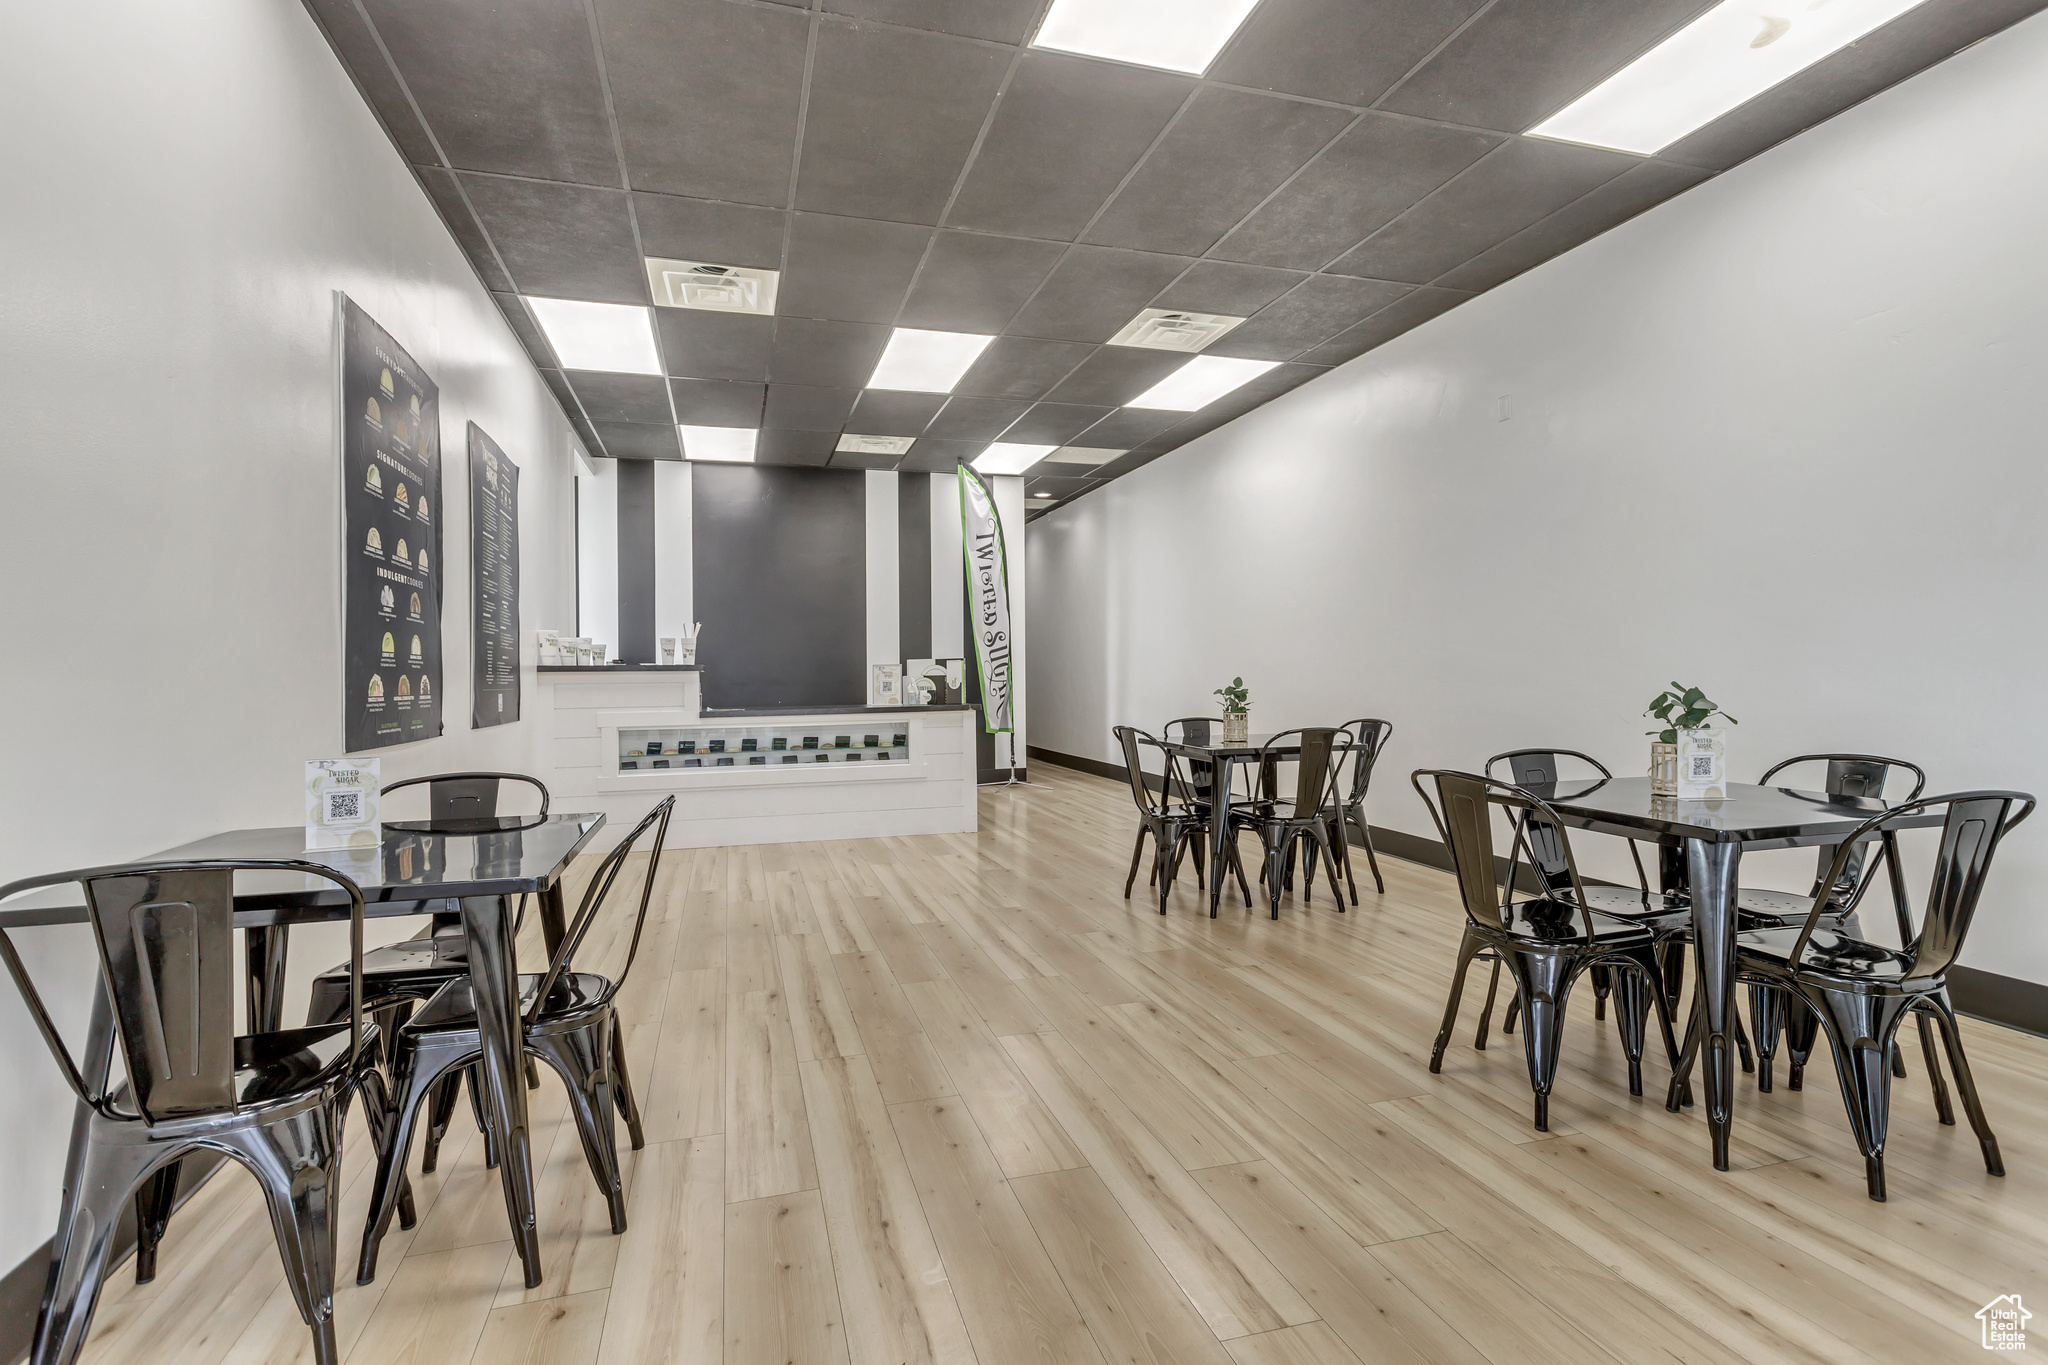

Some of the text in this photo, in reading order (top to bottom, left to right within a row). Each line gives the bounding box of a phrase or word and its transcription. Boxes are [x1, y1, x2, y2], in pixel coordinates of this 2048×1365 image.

[975, 518, 998, 627] TWISTED
[326, 769, 360, 778] TWISTED
[335, 777, 362, 785] SUGAR
